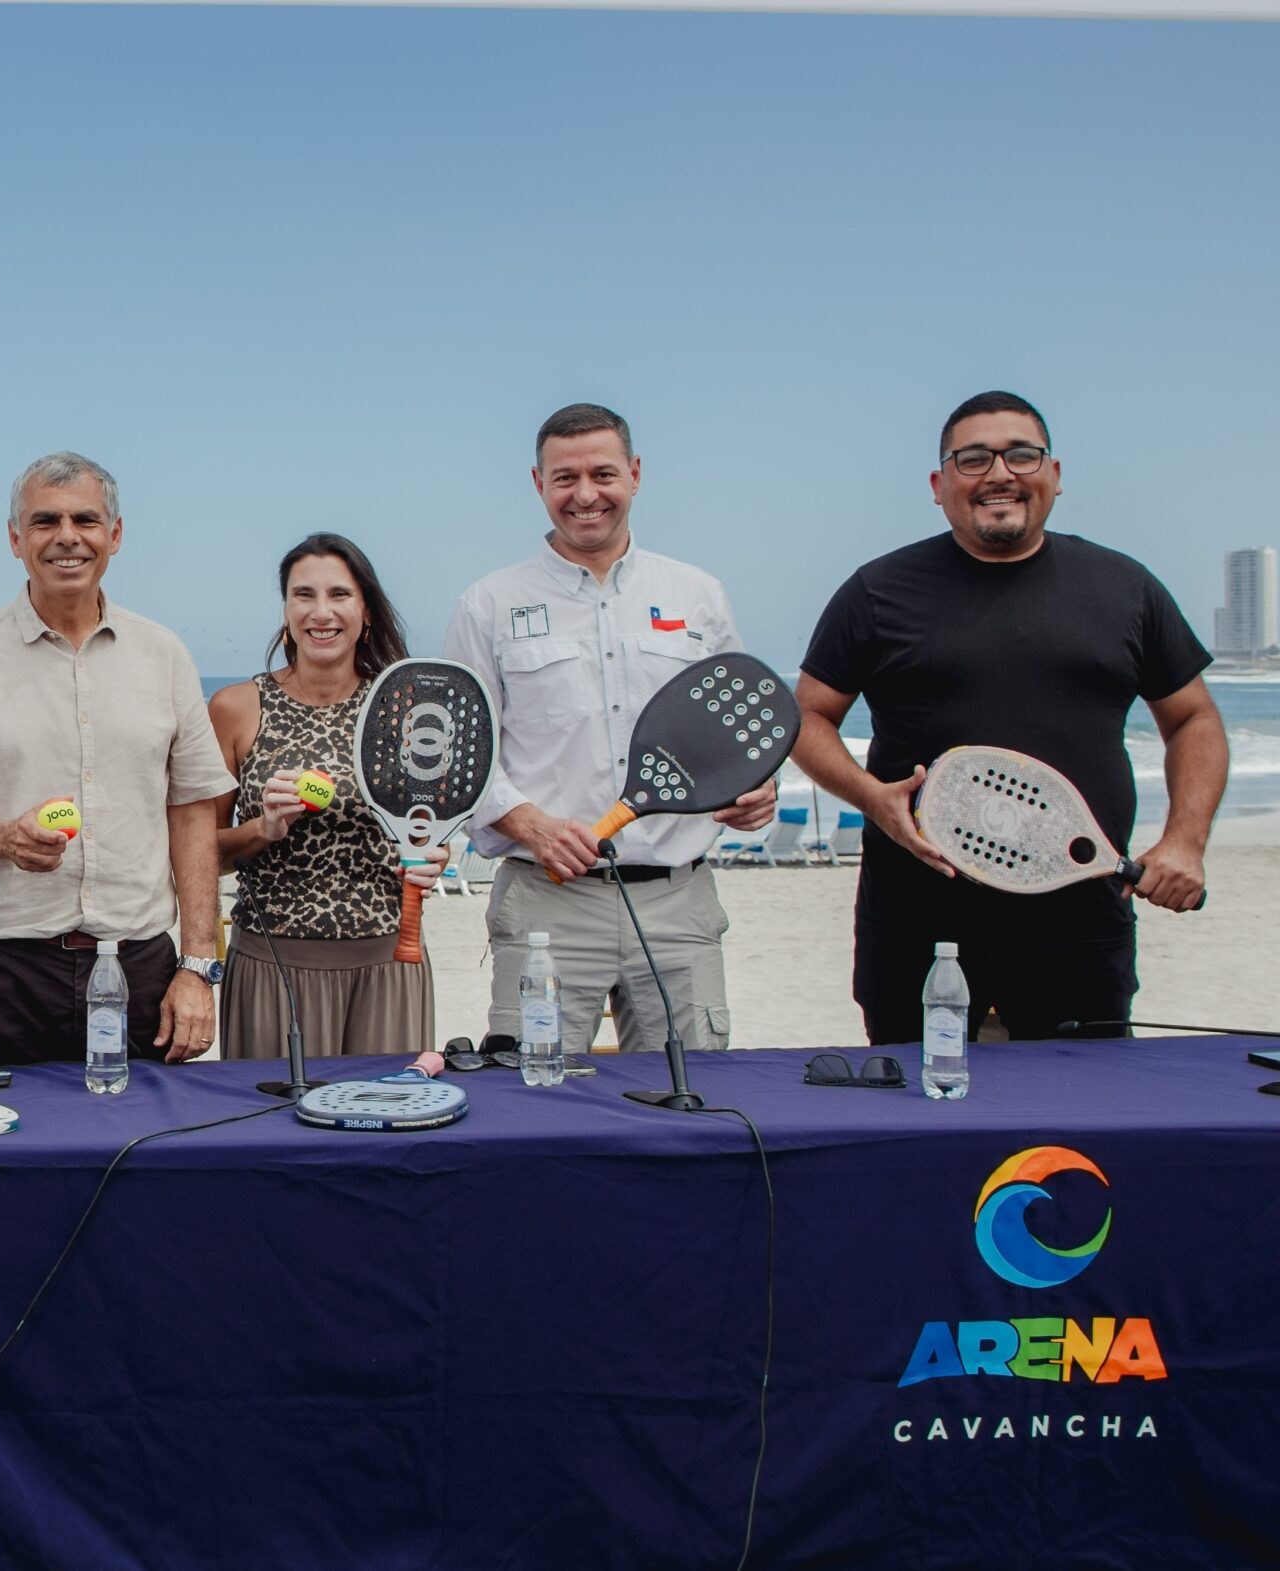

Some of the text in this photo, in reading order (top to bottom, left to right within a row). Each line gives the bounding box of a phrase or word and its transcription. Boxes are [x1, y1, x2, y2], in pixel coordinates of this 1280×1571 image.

[305, 782, 330, 799] JOOG
[411, 793, 435, 802] JOOG
[46, 808, 74, 824] JOOG
[343, 1119, 383, 1129] INSPIRE
[897, 1317, 1168, 1387] ARENA
[894, 1414, 1158, 1443] CAVANCHA
